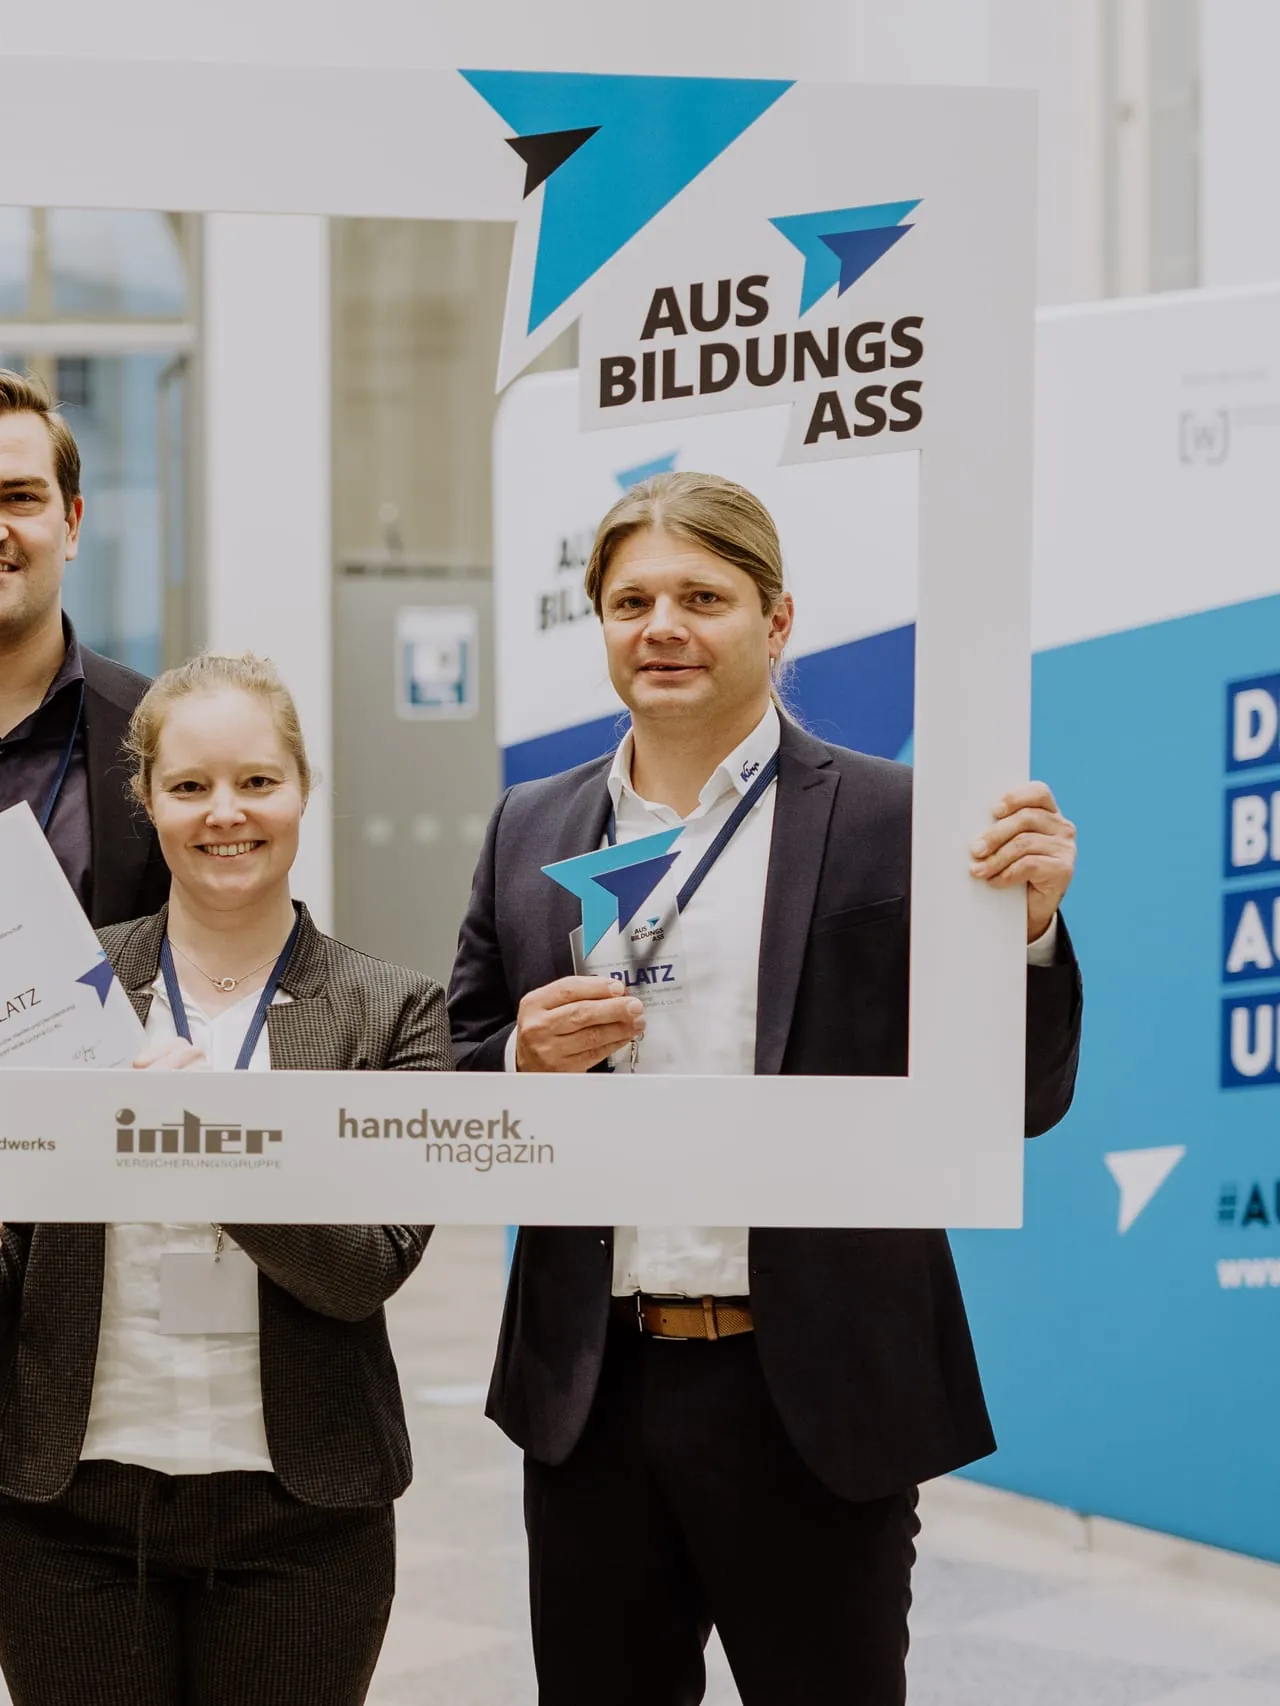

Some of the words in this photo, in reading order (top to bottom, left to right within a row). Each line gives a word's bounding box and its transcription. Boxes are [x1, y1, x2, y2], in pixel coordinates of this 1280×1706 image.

[640, 274, 770, 340] AUS
[599, 316, 924, 408] BILDUNGS
[803, 380, 923, 445] ASS
[115, 1108, 283, 1155] inter
[338, 1108, 523, 1140] handwerk
[115, 1158, 283, 1170] VERSICHERUNGSGRUPPE
[425, 1136, 555, 1173] magazin
